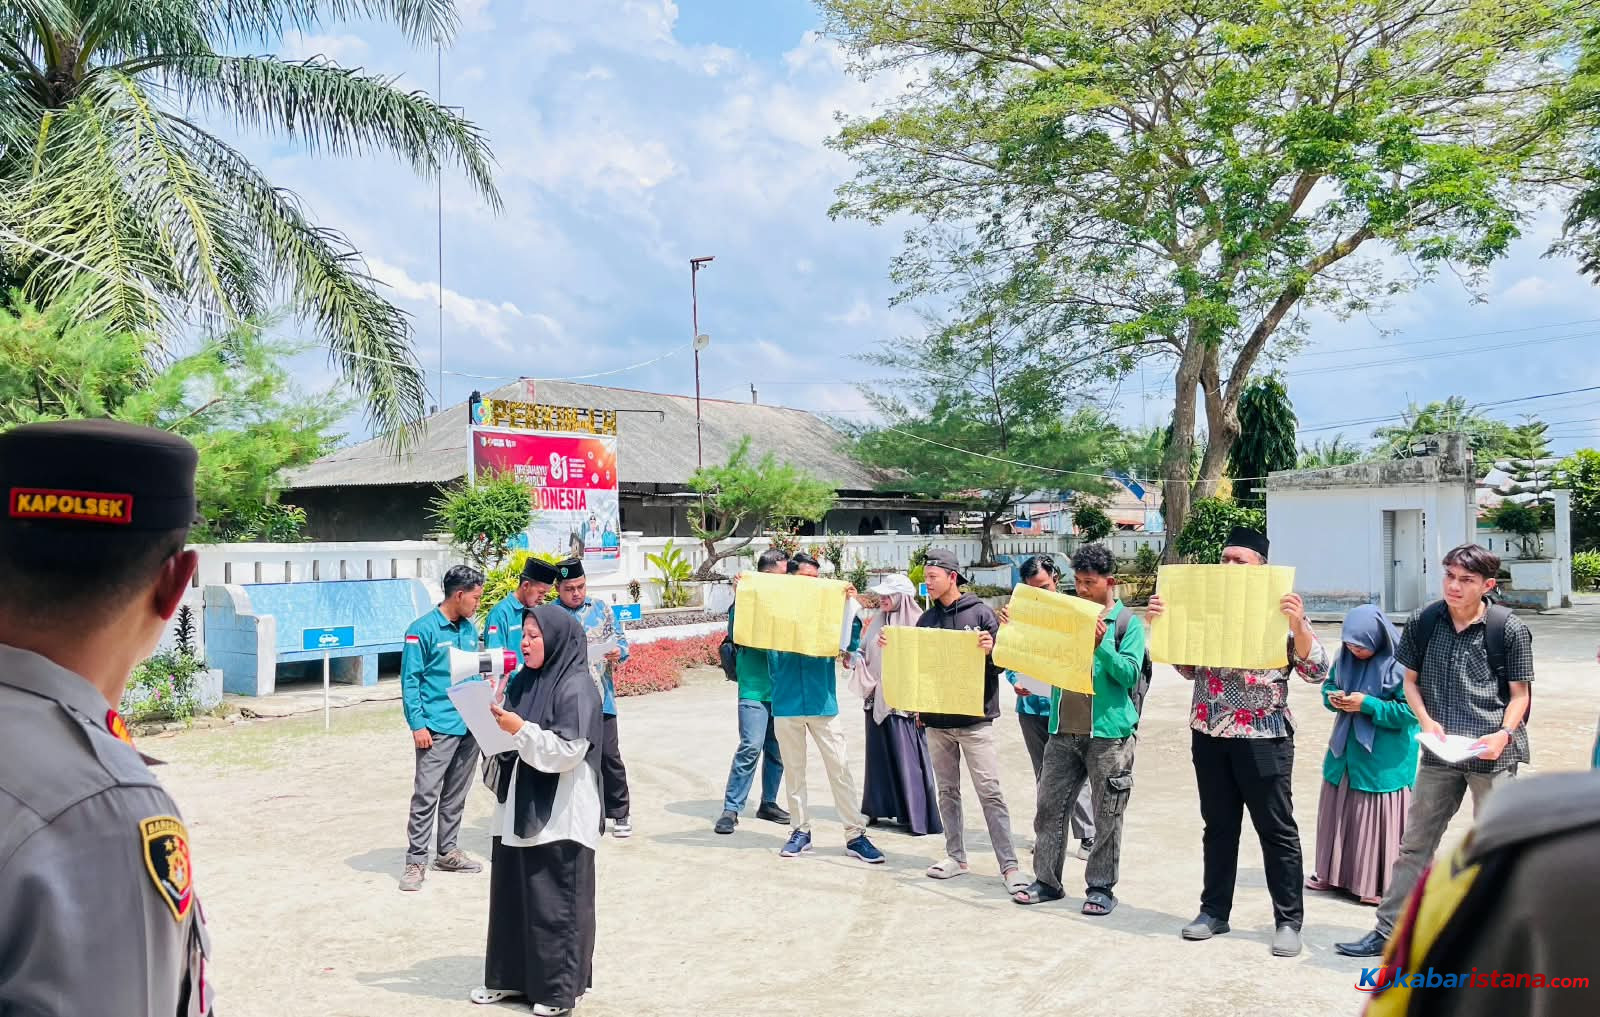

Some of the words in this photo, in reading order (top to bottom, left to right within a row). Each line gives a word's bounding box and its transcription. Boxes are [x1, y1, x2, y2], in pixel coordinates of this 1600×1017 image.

[549, 452, 568, 483] 81
[18, 494, 123, 517] KAPOLSEK
[530, 488, 587, 511] DONESIA
